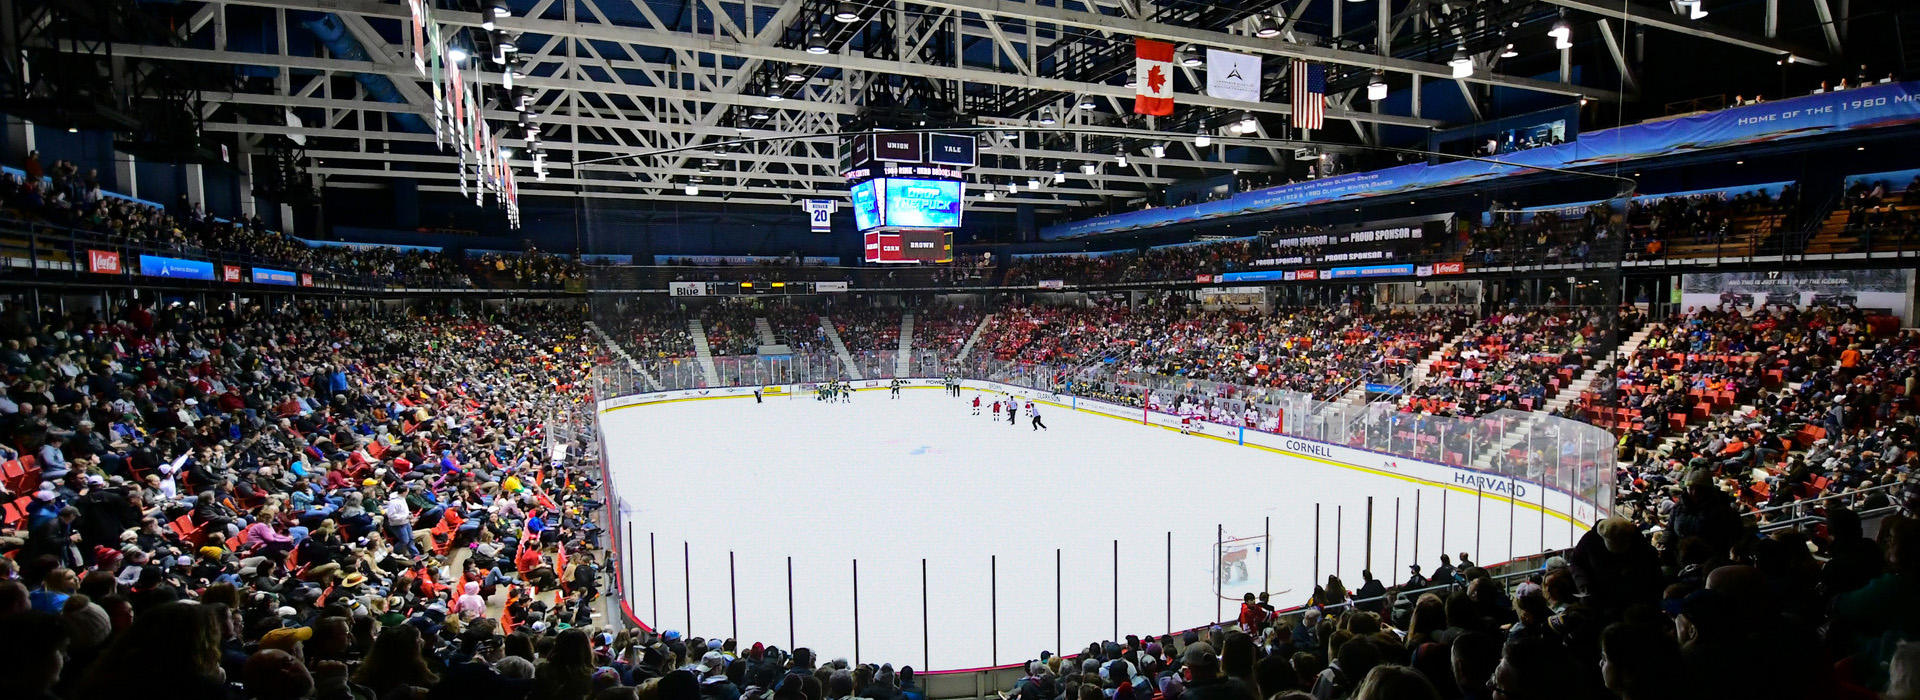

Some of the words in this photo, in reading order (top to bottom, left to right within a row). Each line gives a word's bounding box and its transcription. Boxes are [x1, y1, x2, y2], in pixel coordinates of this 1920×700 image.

[1738, 114, 1776, 126] HOME
[1782, 110, 1800, 119] OF
[1805, 105, 1833, 115] THE
[1842, 97, 1886, 110] 1980
[887, 142, 909, 150] UNION
[944, 145, 961, 153] YALE
[1357, 174, 1379, 182] CENTER
[1347, 183, 1370, 191] WINTER
[1370, 179, 1394, 188] GAMES
[895, 200, 918, 209] THE
[921, 200, 951, 210] PUCK
[814, 209, 828, 222] 20
[1350, 230, 1374, 242] PROUD
[1375, 228, 1410, 240] SPONSOR
[1279, 237, 1299, 248] PROUD
[1299, 235, 1328, 247] SPONSOR
[1325, 254, 1348, 262] PROUD
[1349, 251, 1382, 260] SPONSOR
[1567, 276, 1575, 284] 18
[1768, 271, 1779, 279] 17
[133, 288, 139, 299] 8
[676, 287, 699, 296] Blue
[1286, 440, 1332, 458] CORNELL
[1455, 472, 1526, 497] HARVARD
